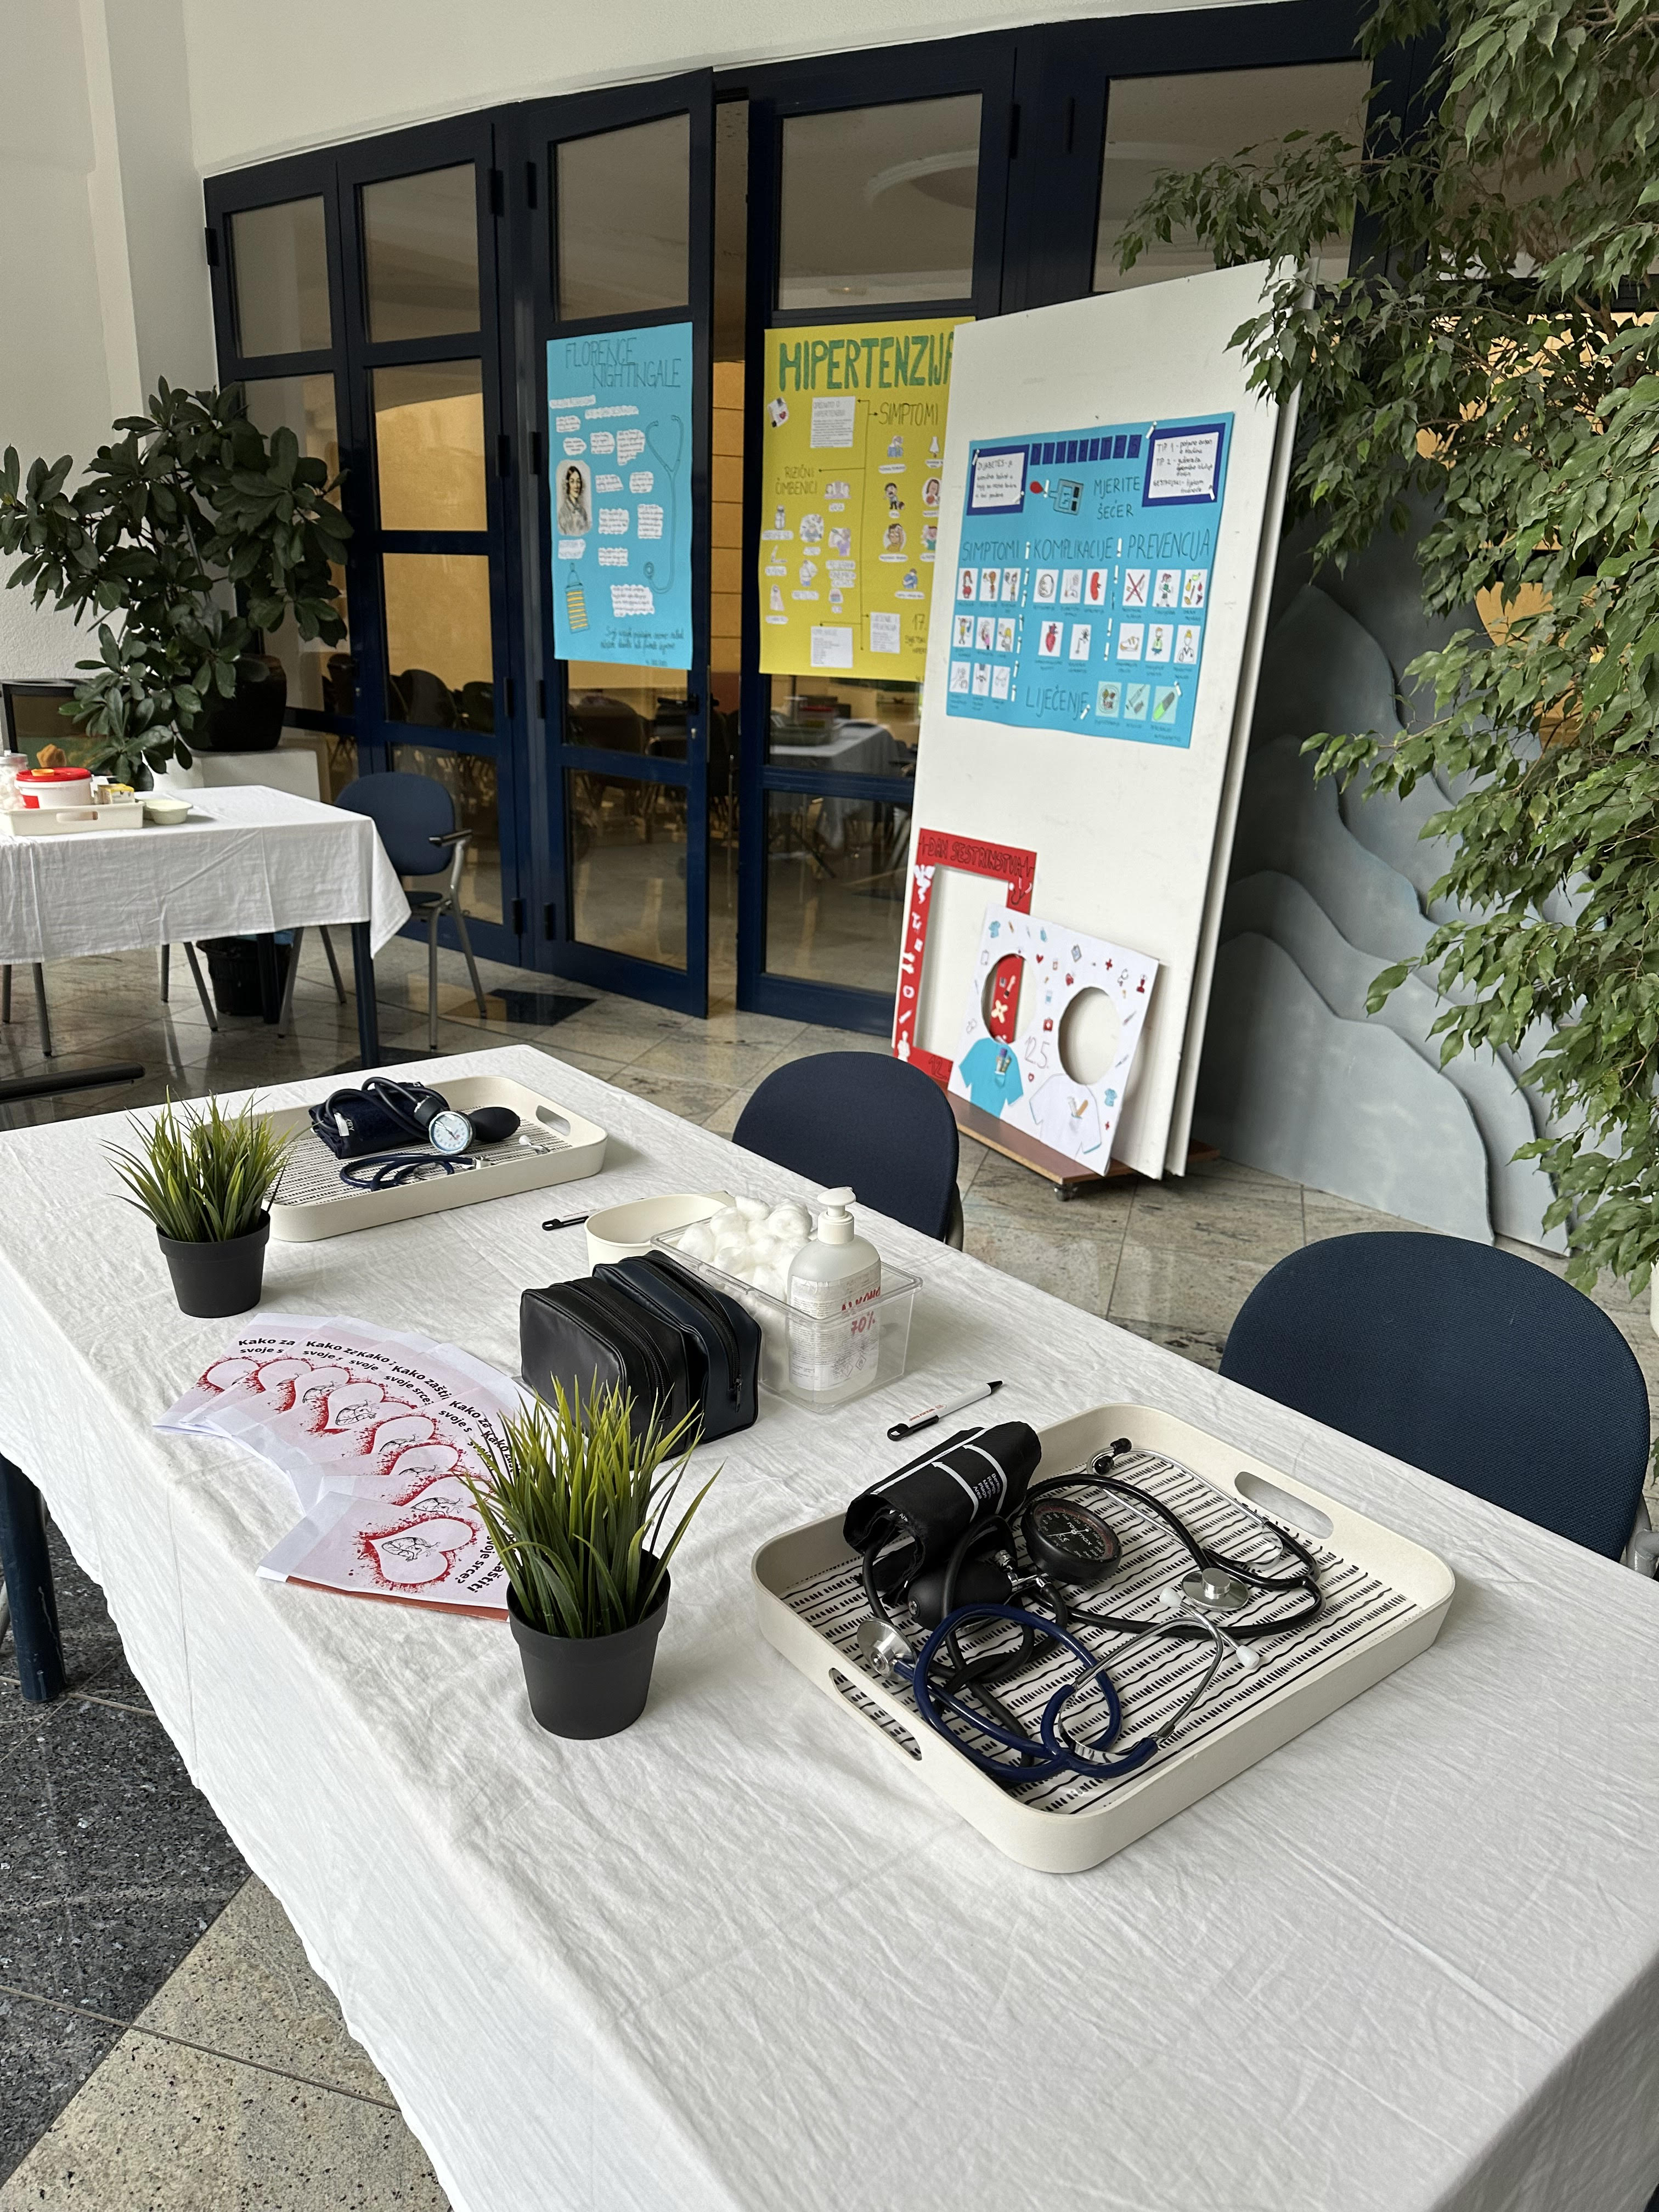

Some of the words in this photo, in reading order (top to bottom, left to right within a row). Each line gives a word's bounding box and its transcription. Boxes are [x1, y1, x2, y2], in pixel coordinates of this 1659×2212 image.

[566, 337, 637, 369] FLORENCE
[592, 358, 681, 388] NIGHTINGALE
[879, 402, 939, 426] SIMPTOMI
[1156, 443, 1167, 453] TIP
[784, 464, 815, 478] RIZIČNI
[1156, 458, 1164, 466] TIP
[775, 478, 817, 495] ČIMBENICI
[1093, 476, 1141, 500] MJERITE
[1097, 500, 1134, 521] ŠEĆER
[962, 539, 1019, 562] SIMPTOMI
[1034, 536, 1114, 562] KOMPLIKACIJE
[1128, 528, 1210, 561] PREVENCIJA
[1026, 684, 1090, 721] LIJEČENJE
[928, 837, 949, 860] DAN
[950, 841, 1023, 877] SESTRINSTVA
[851, 1311, 876, 1335] 70%
[238, 1338, 277, 1346] Kako
[306, 1340, 343, 1351] Kako
[303, 1349, 336, 1360] svoje
[356, 1351, 391, 1363] Kako
[348, 1359, 379, 1372] svoje
[391, 1365, 426, 1380] Kako
[383, 1375, 414, 1390] svoje
[438, 1409, 467, 1427] svoje
[449, 1400, 481, 1419] Kako
[1066, 1522, 1092, 1545] romax
[479, 1536, 495, 1559] svoje
[454, 1560, 484, 1584] srce?
